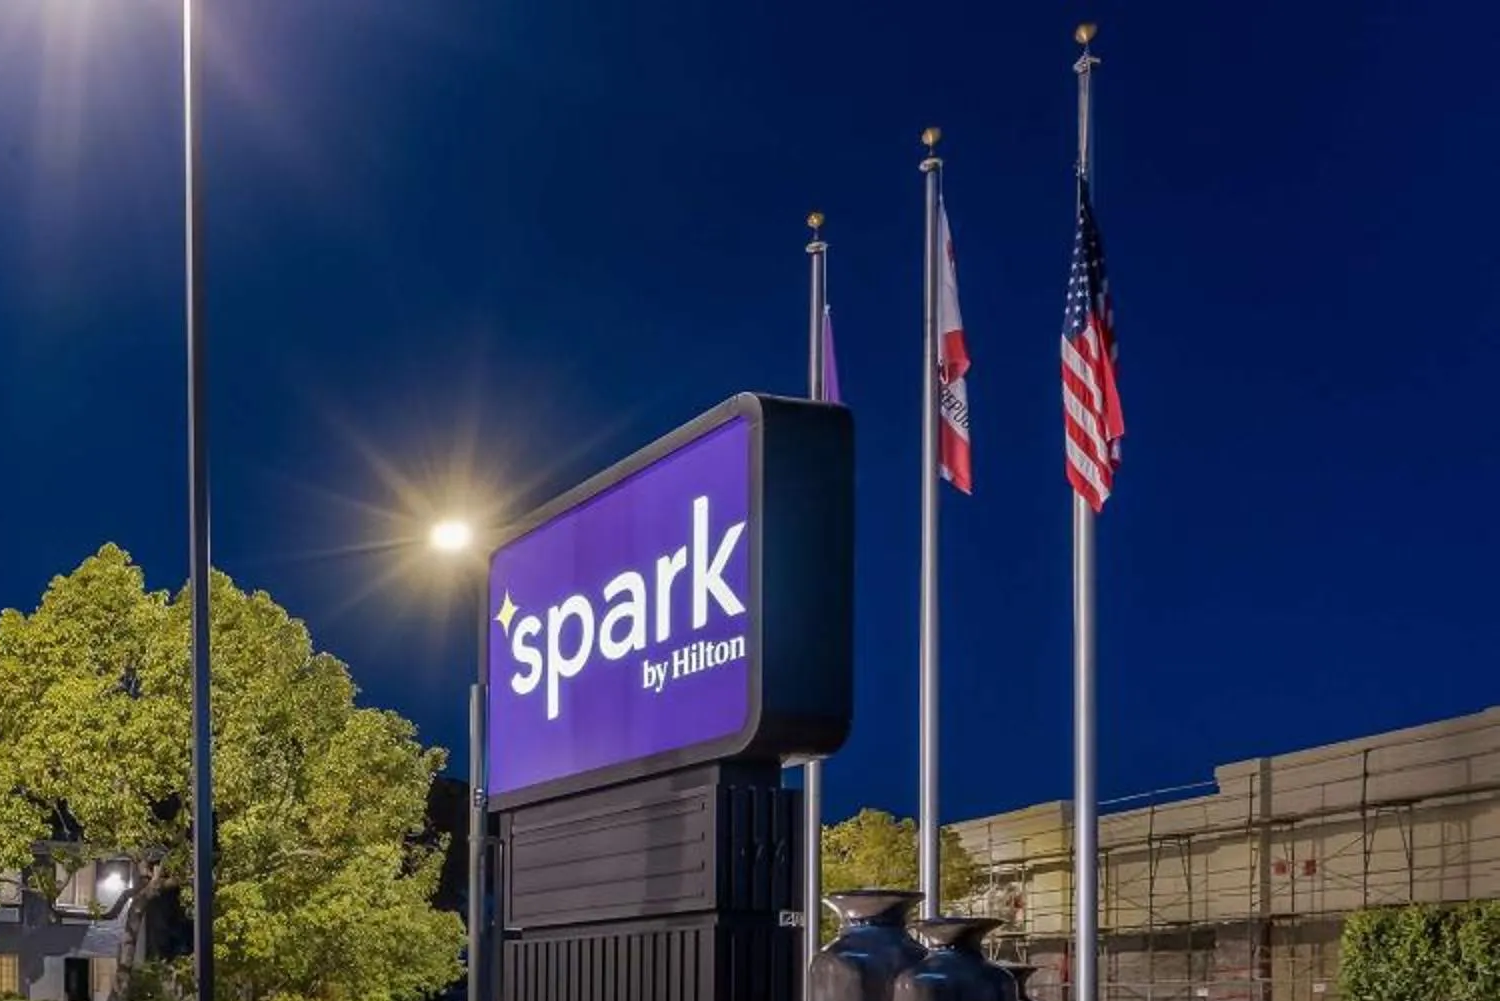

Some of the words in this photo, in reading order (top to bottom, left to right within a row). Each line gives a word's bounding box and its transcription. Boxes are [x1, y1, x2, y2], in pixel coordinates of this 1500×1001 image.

[511, 495, 746, 720] spark
[643, 660, 668, 692] by
[672, 635, 745, 679] Hilton
